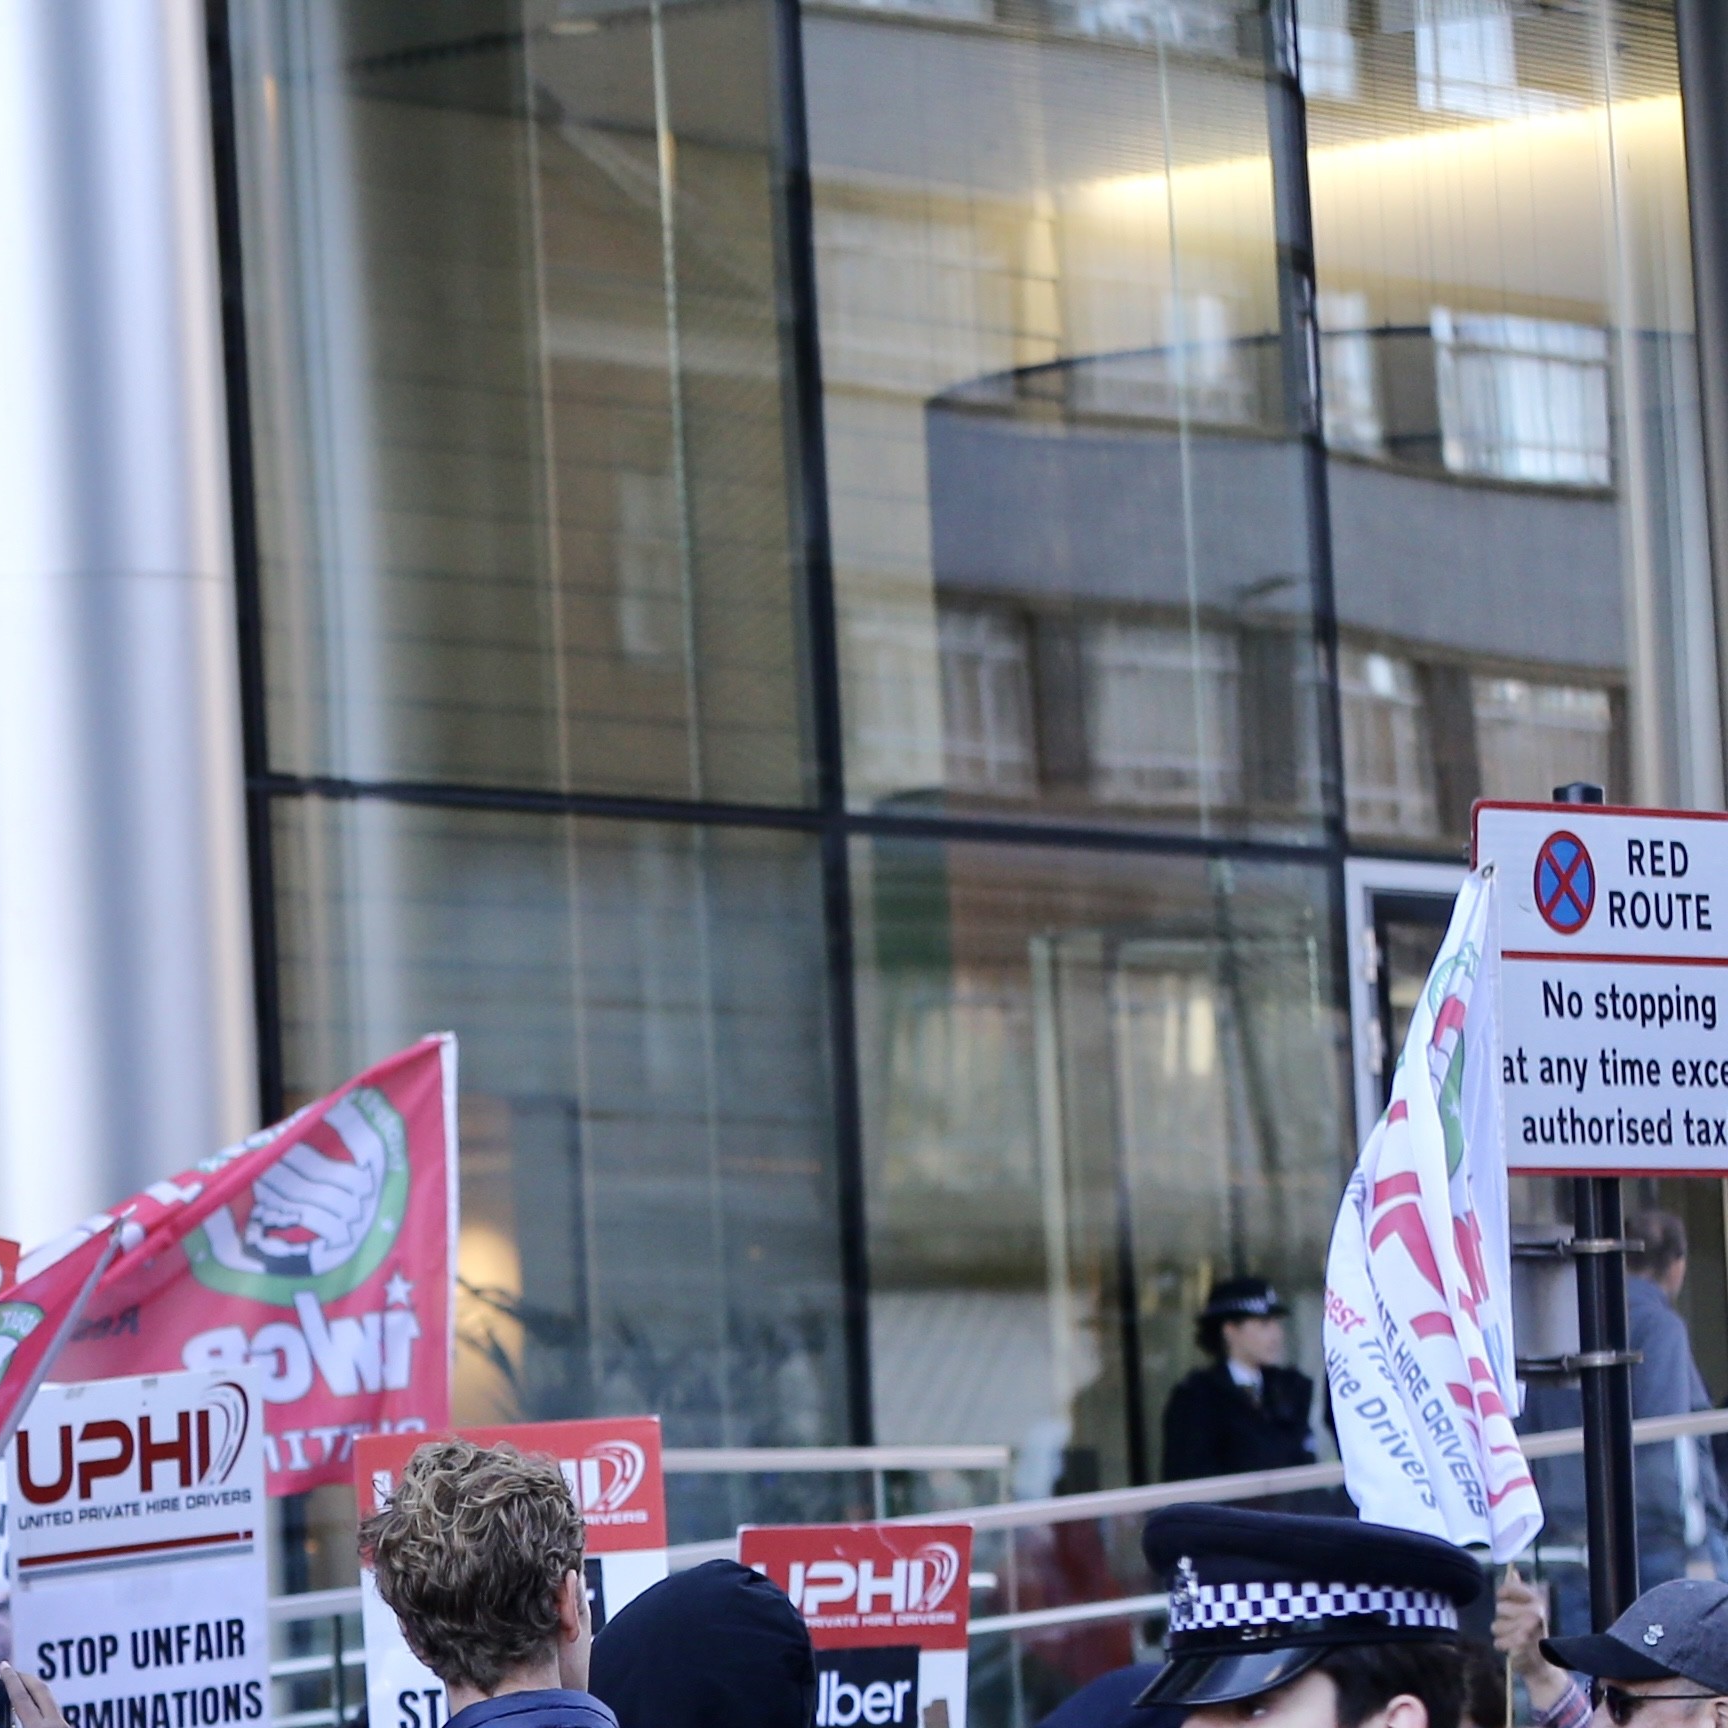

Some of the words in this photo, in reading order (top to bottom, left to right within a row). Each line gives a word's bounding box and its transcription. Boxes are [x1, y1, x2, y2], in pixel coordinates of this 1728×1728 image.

[1627, 839, 1689, 878] RED
[1608, 890, 1712, 931] ROUTE
[1542, 980, 1583, 1019] No
[1594, 982, 1718, 1030] stopping
[1539, 1055, 1588, 1093] any
[1599, 1047, 1661, 1087] time
[1671, 1058, 1728, 1087] exce
[1522, 1106, 1673, 1146] authorised
[1683, 1108, 1728, 1147] tax
[1394, 1341, 1430, 1404] HIRE
[1421, 1400, 1489, 1519] DRIVERS
[18, 1510, 74, 1531] UNITED
[79, 1503, 140, 1524] PRIVATE
[146, 1498, 180, 1515] HIRE
[186, 1489, 252, 1510] DRIVERS
[38, 1634, 118, 1682] STOP
[132, 1618, 245, 1671] UNFAIR
[817, 1671, 911, 1727] ber
